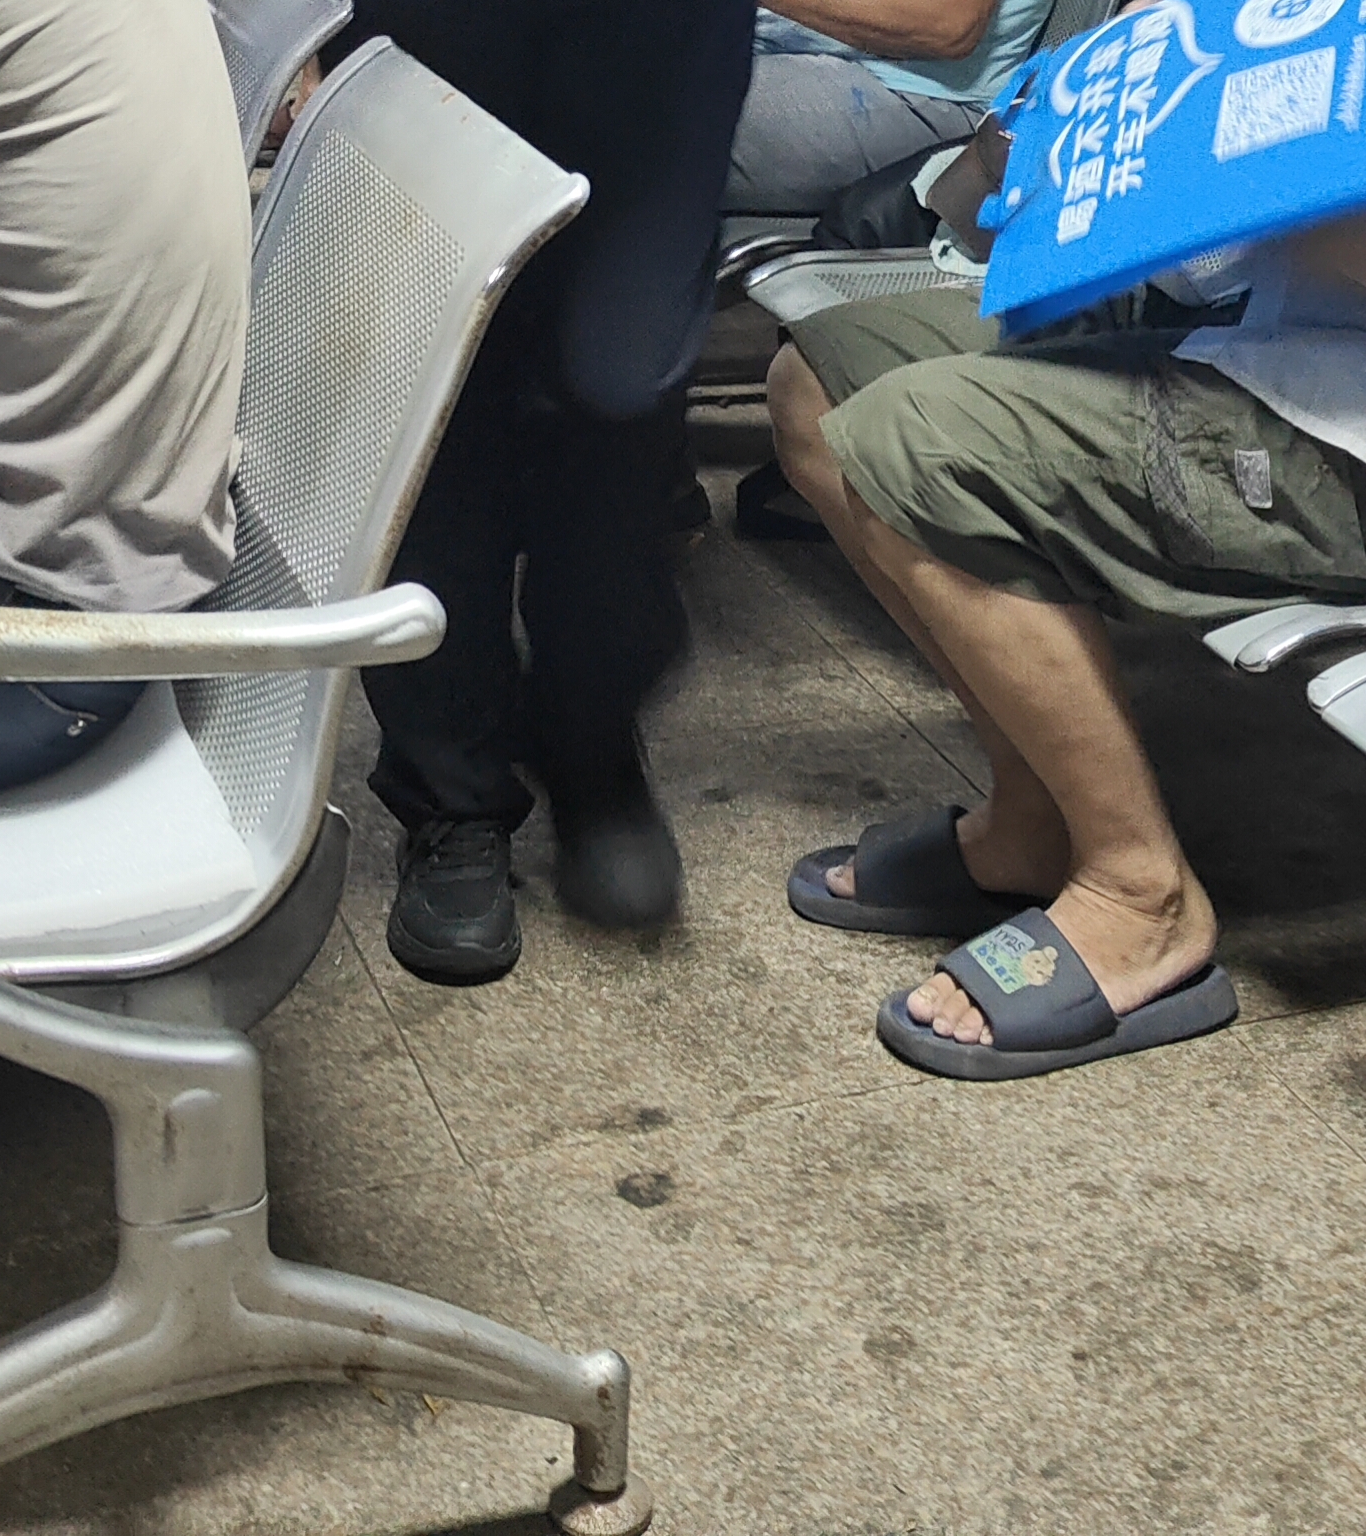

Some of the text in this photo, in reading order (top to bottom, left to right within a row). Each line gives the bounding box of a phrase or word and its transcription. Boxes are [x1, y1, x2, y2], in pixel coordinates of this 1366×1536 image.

[1056, 35, 1128, 247] 喝酒不开车
[1106, 5, 1175, 202] 开车不喝酒
